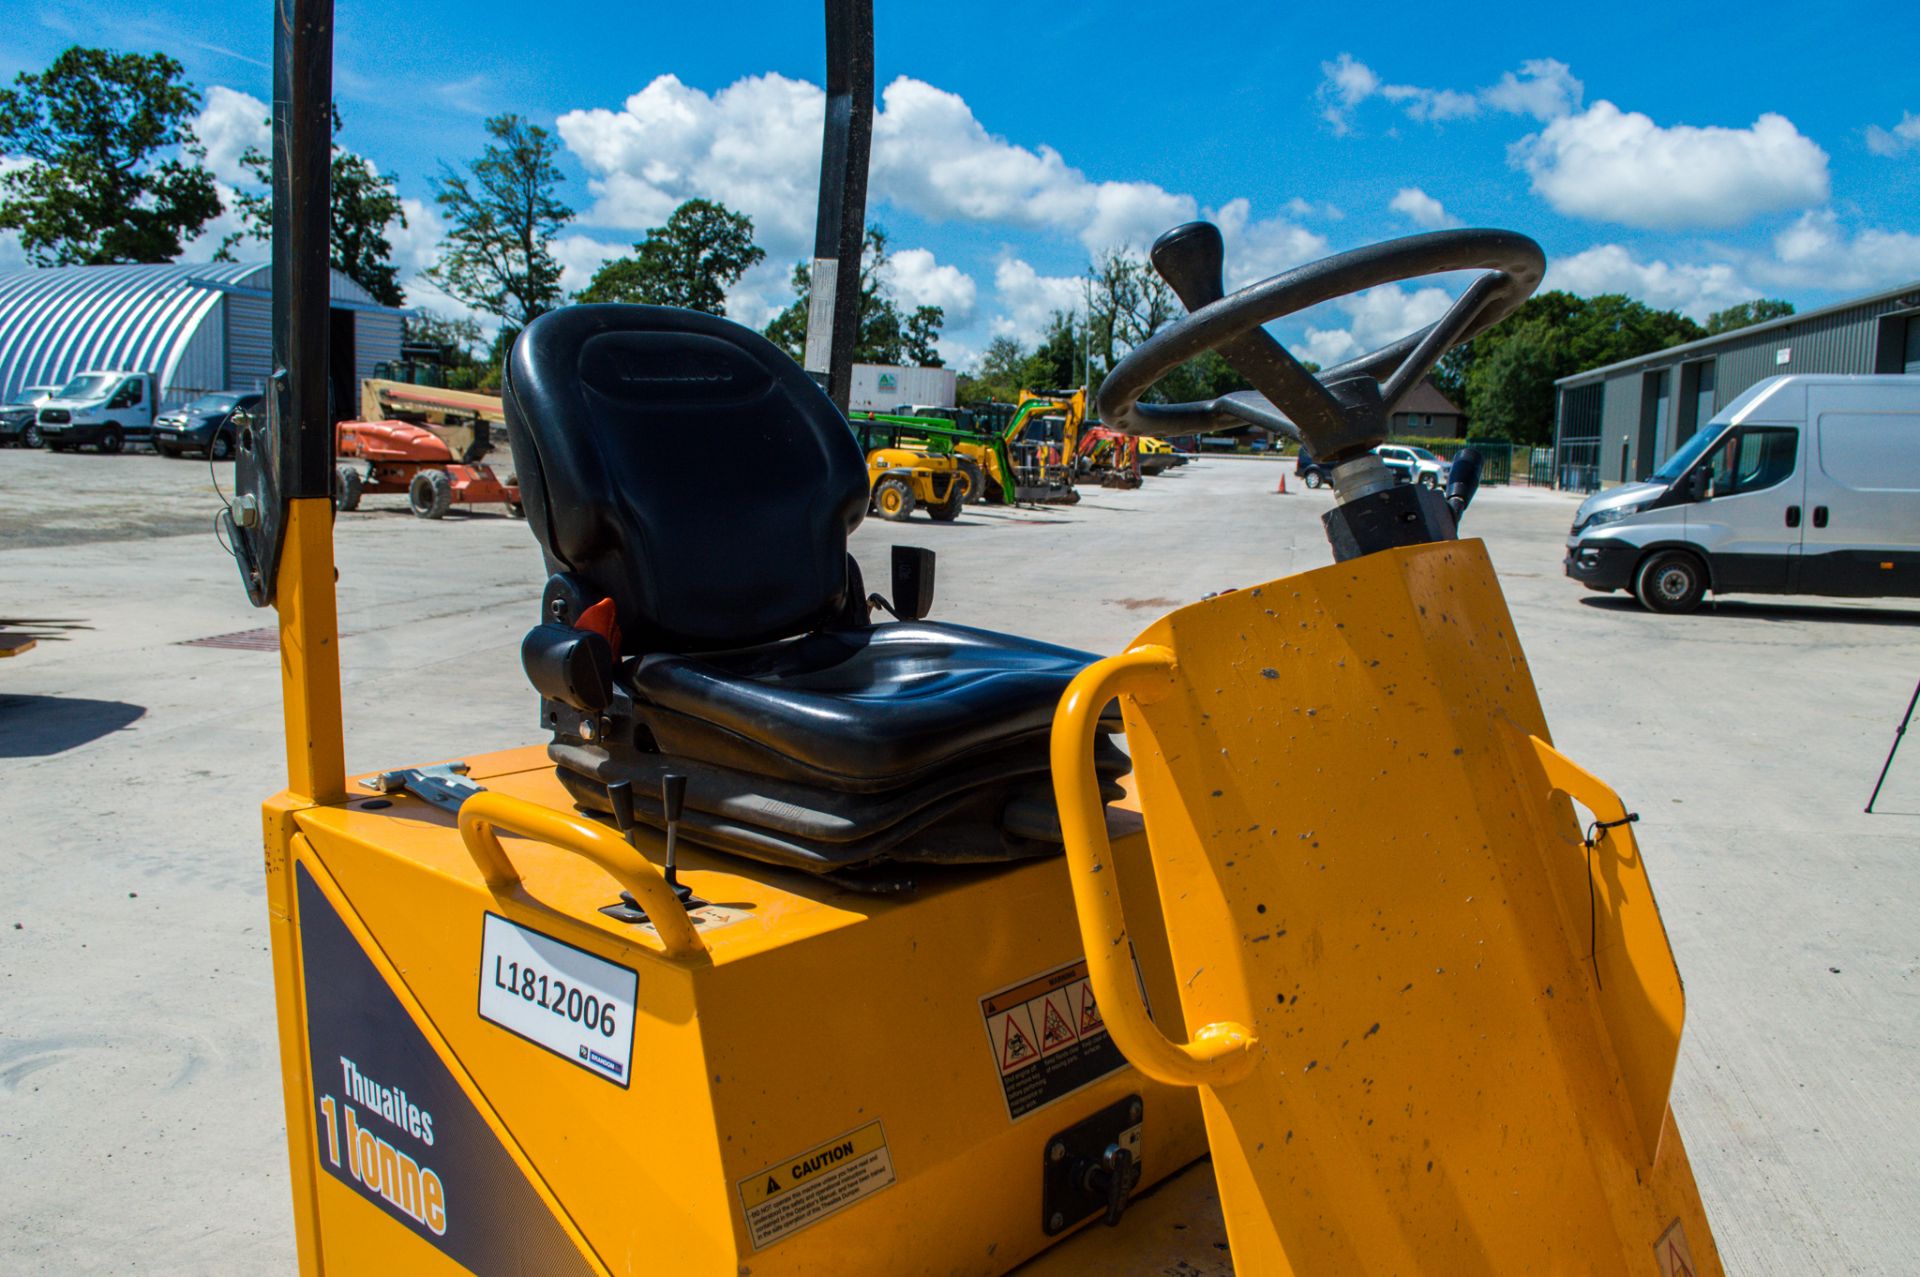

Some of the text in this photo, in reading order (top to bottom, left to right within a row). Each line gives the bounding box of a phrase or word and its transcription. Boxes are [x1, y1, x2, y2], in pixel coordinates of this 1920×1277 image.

[495, 954, 616, 1038] L1812006
[339, 1055, 435, 1147] Thwaites
[319, 1093, 447, 1237] 1 tonne
[791, 1140, 855, 1180] CAUTION
